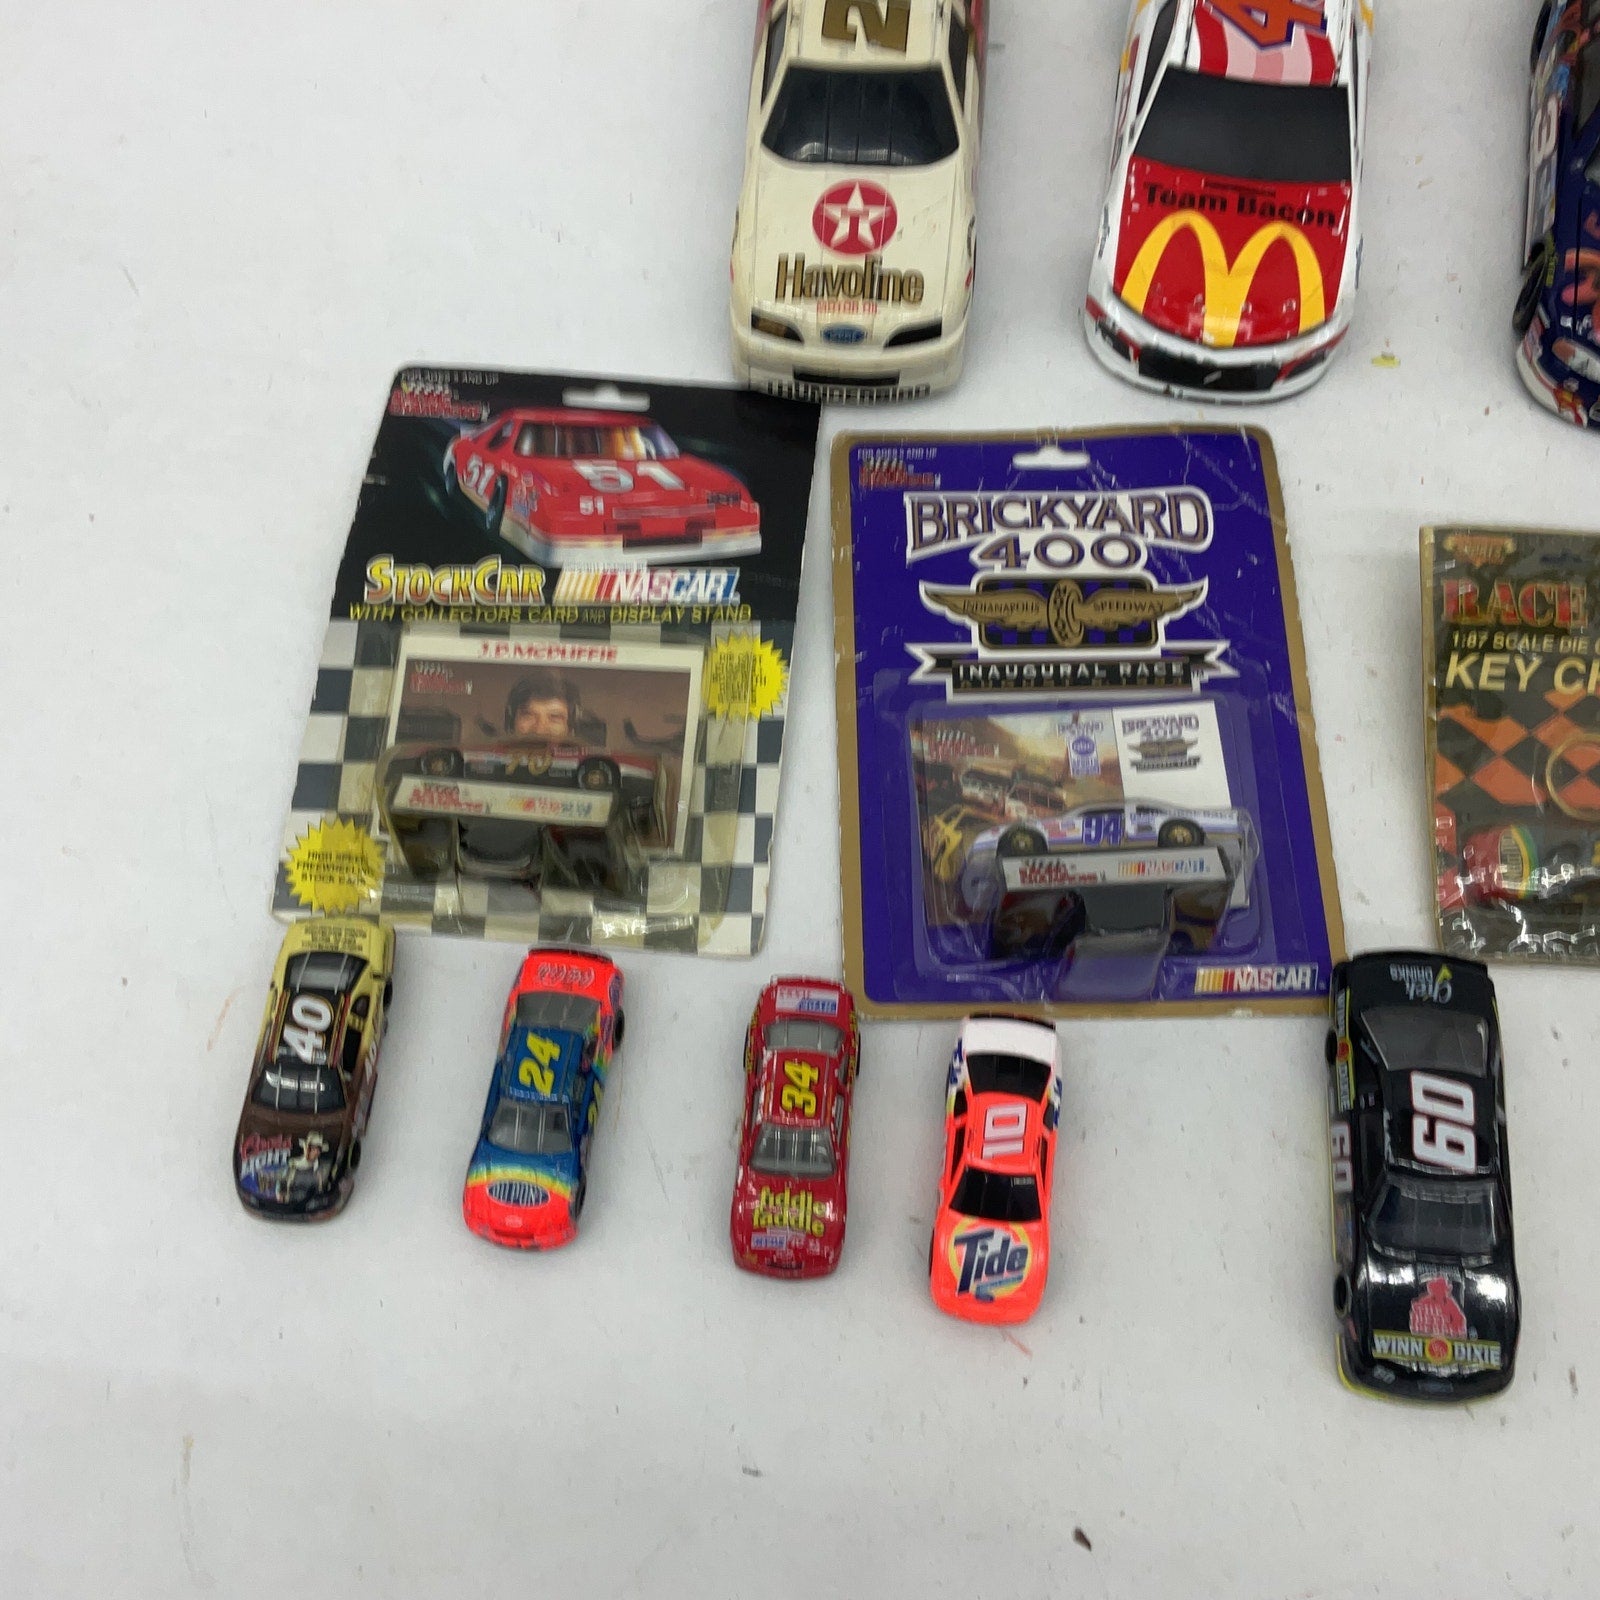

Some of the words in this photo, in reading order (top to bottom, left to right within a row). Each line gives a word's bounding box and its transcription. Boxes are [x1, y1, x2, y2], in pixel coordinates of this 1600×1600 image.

[1144, 182, 1227, 212] Team
[1237, 195, 1336, 227] Bacon
[775, 252, 925, 307] Havoline
[466, 453, 495, 496] 51
[572, 459, 685, 493] 51
[906, 489, 1211, 558] BRICKYARD
[975, 532, 1143, 570] 400
[611, 568, 732, 603] NASCAR
[1442, 577, 1589, 629] RACE
[350, 603, 396, 621] WITH
[401, 604, 521, 623] COLLECTORS
[528, 605, 579, 623] CARD
[610, 604, 685, 624] DISPLAY
[691, 604, 752, 624] STAND
[1492, 631, 1555, 653] SCALE
[1559, 634, 1591, 655] DIE
[959, 662, 1107, 681] INAUGURAL
[1119, 661, 1184, 680] RACE
[1444, 651, 1543, 693] KEY
[1233, 965, 1312, 993] NASCAR
[283, 994, 335, 1064] 40
[519, 1030, 562, 1095] 24
[782, 1060, 819, 1118] 34
[982, 1103, 1028, 1160] 10
[1409, 1068, 1476, 1174] 60
[1331, 1121, 1353, 1193] 60
[953, 1228, 1029, 1296] Tide
[1374, 1335, 1424, 1358] WINN
[1454, 1341, 1502, 1367] DIXIE
